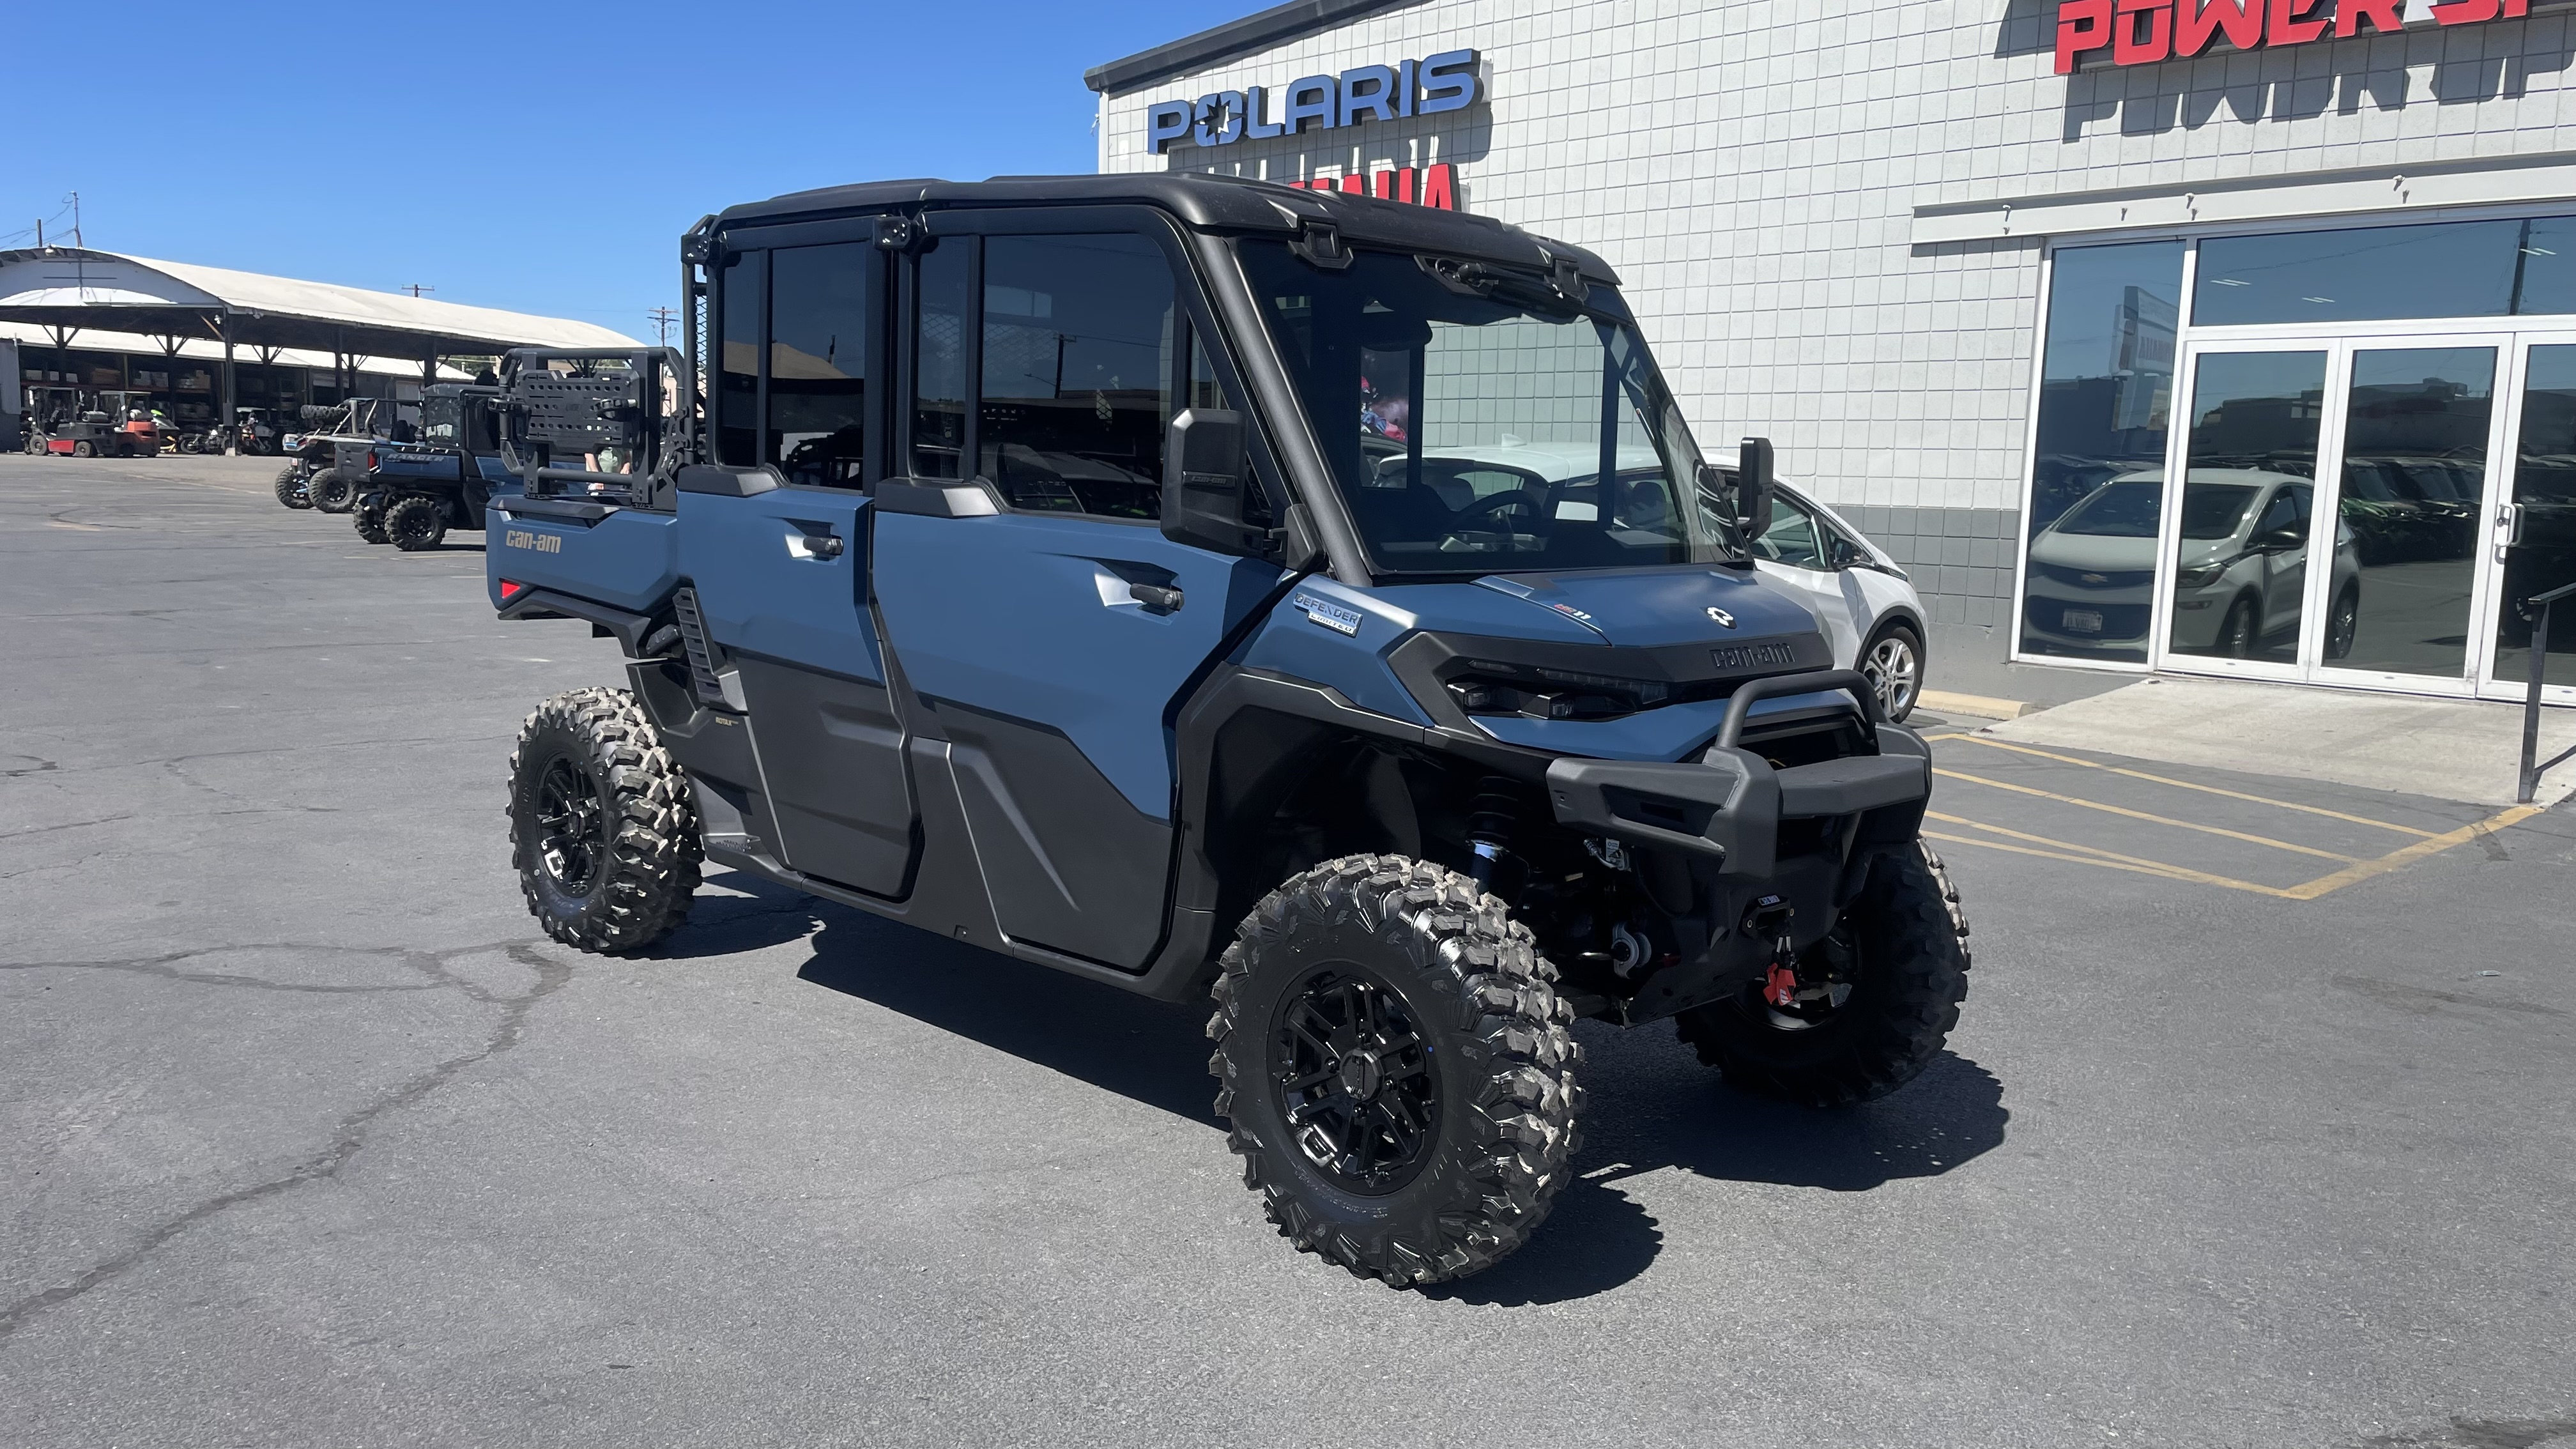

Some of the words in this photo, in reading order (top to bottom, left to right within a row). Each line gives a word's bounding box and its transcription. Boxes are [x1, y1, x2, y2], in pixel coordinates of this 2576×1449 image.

[1148, 49, 1480, 155] POLARIS
[505, 530, 562, 553] can-am
[1294, 593, 1359, 624] DEFENDER
[1709, 642, 1797, 670] can-am
